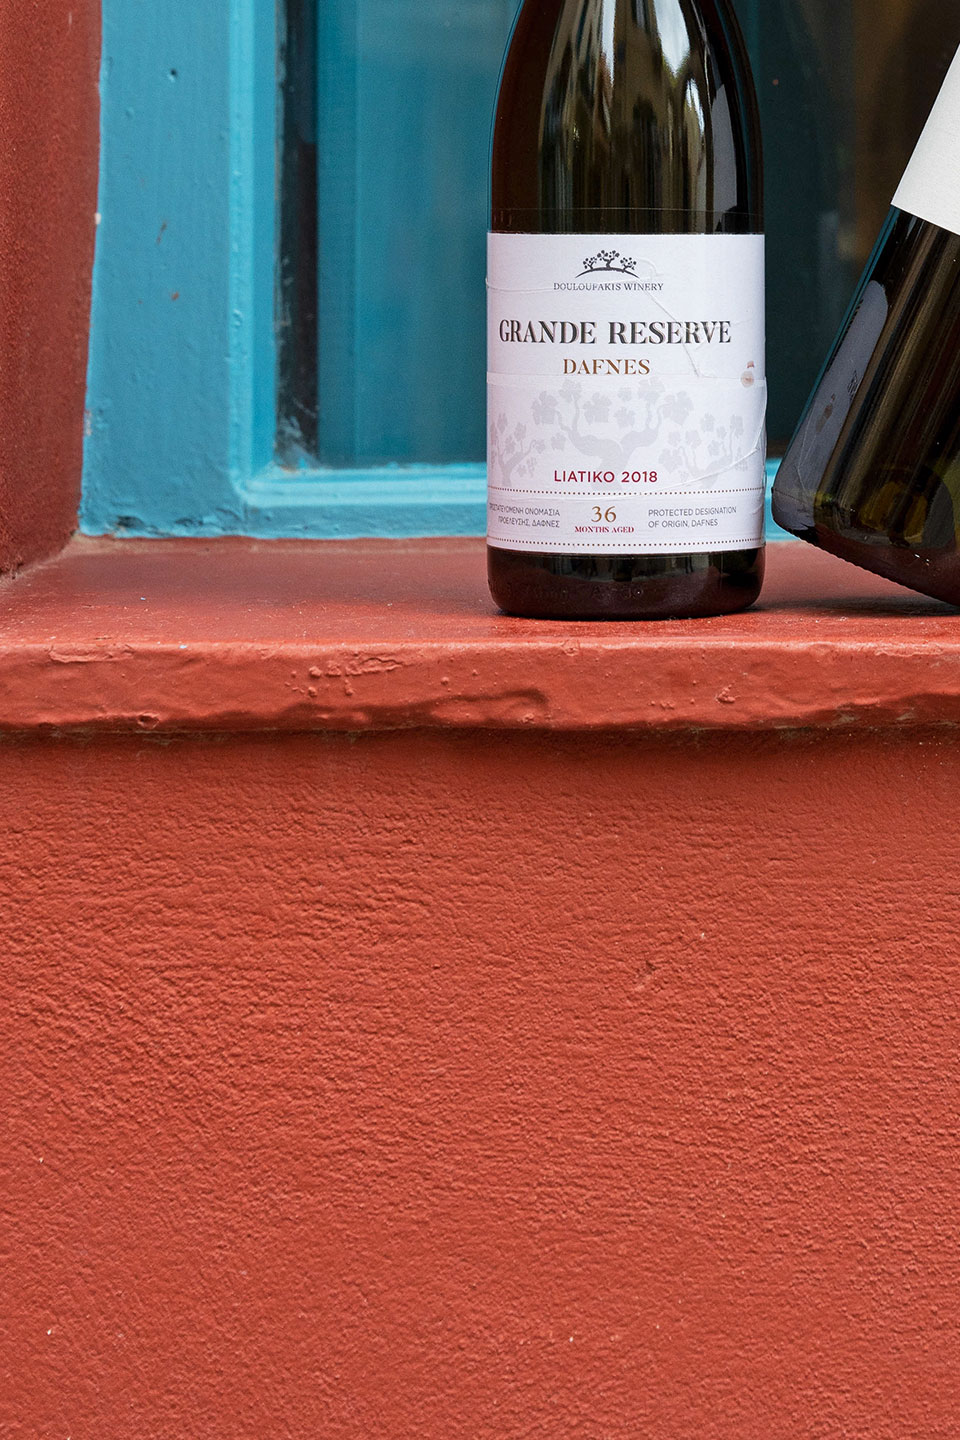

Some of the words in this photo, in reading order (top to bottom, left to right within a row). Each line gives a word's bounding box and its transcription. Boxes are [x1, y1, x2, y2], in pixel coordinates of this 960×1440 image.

[553, 282, 622, 292] DOULOUFAKIS
[623, 282, 664, 291] WINERY
[499, 319, 596, 344] GRANDE
[608, 320, 731, 345] RESERVE
[563, 358, 650, 375] DAFNES
[554, 469, 615, 483] LIATIKO
[621, 470, 658, 483] 2018
[591, 505, 617, 523] 36
[648, 508, 693, 517] PROTECTED
[694, 506, 737, 516] DESIGNATION
[574, 525, 609, 534] MONTHS
[611, 526, 635, 534] AGED
[648, 520, 660, 529] OF
[661, 519, 690, 530] ORIGIN,
[691, 518, 719, 528] DAFNES
